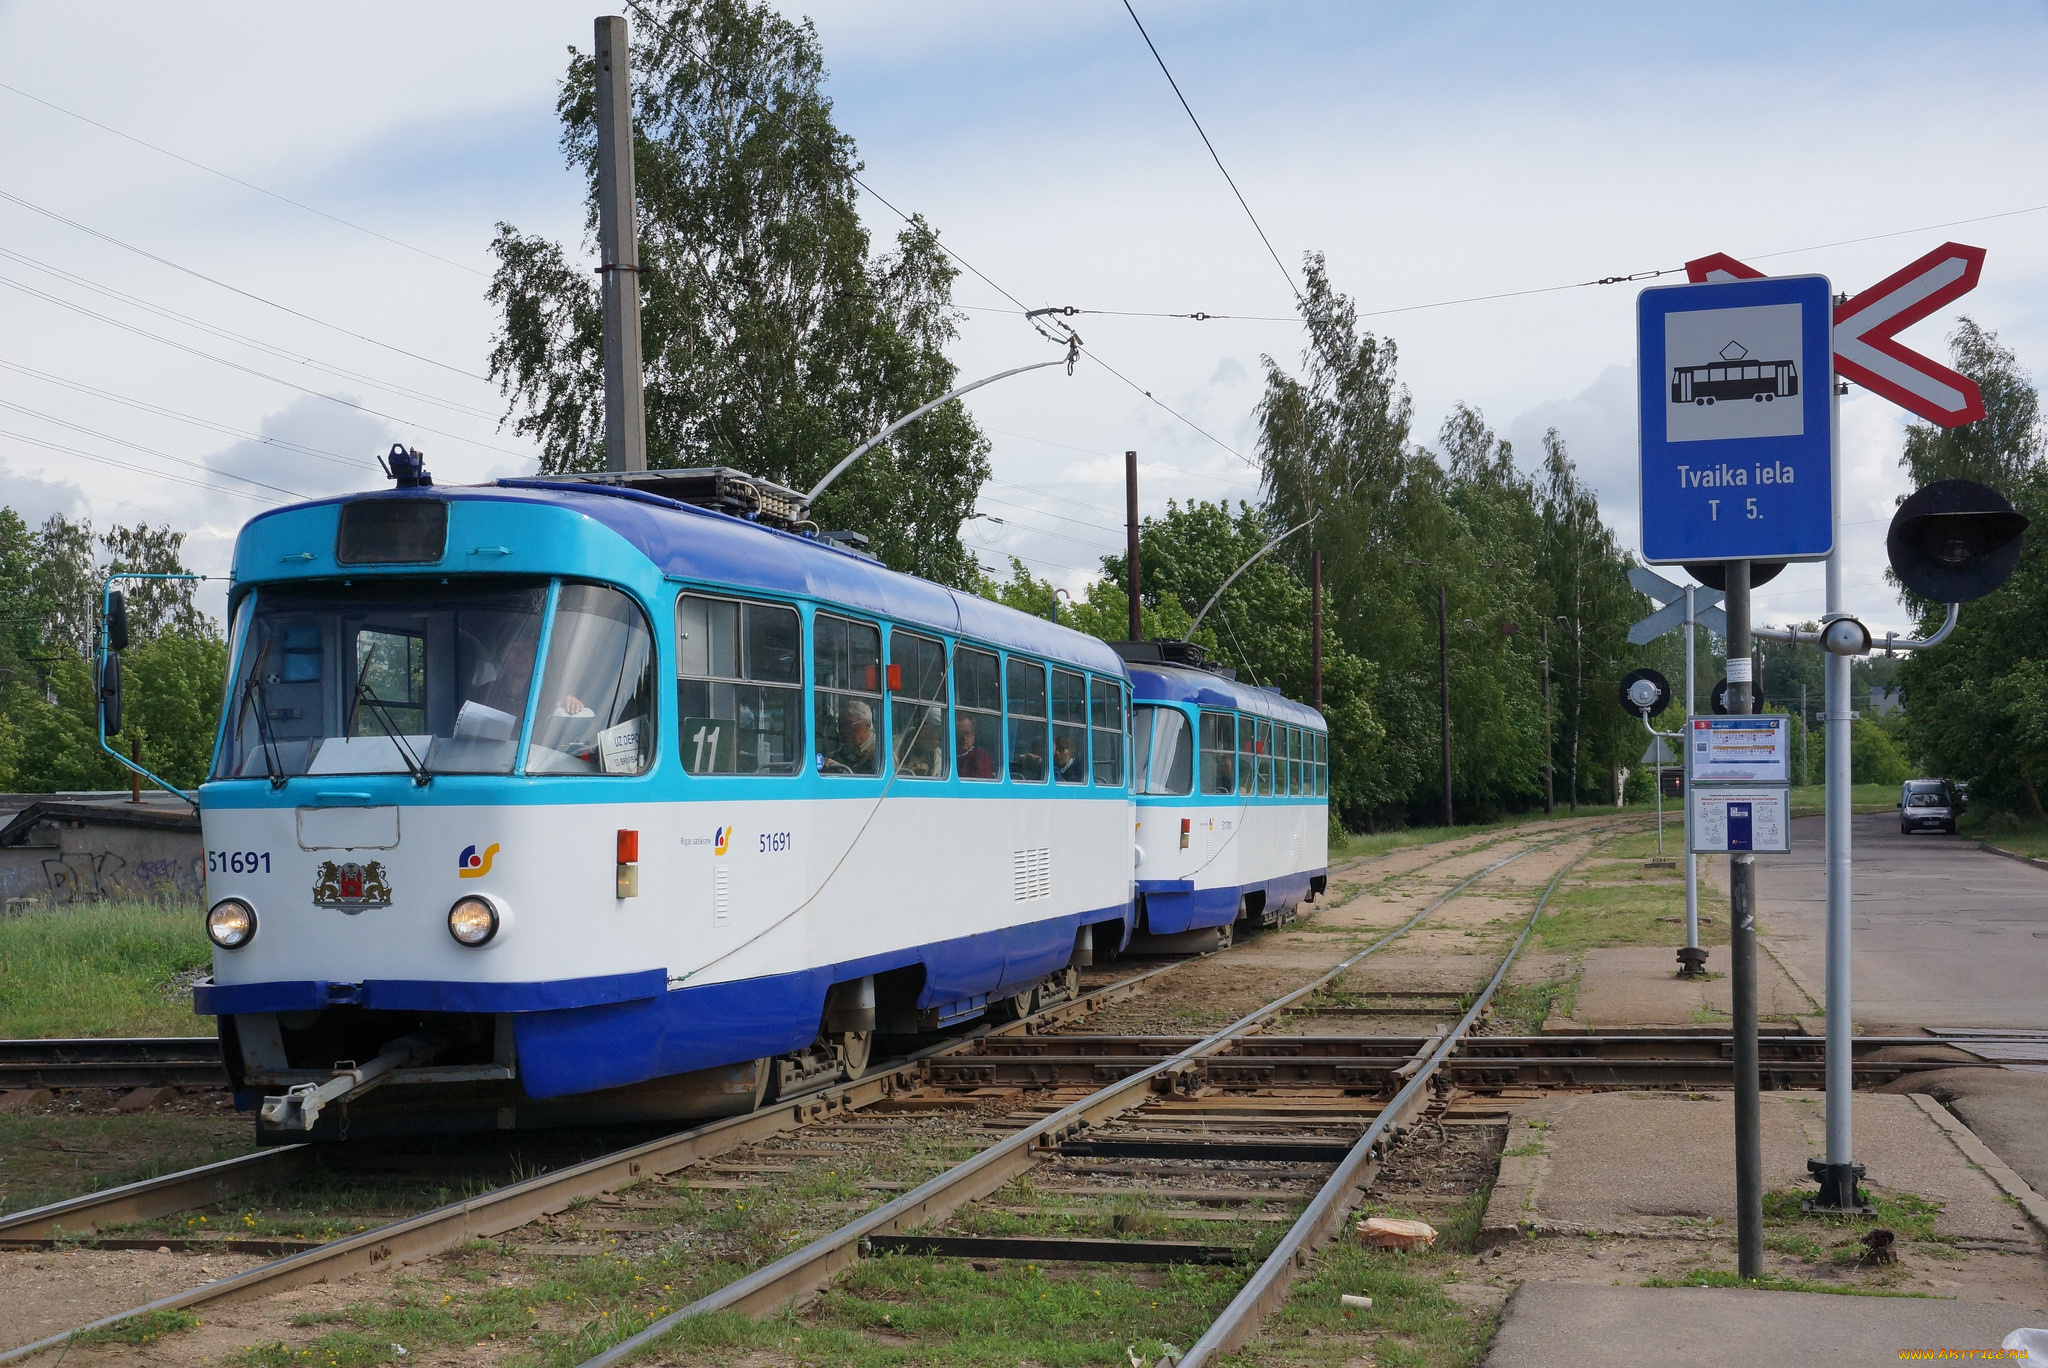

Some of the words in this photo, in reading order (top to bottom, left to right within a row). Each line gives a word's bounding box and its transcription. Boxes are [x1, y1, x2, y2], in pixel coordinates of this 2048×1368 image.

[1677, 463, 1747, 488] Tvaika
[1755, 460, 1794, 485] iela
[1708, 499, 1720, 521] T
[1746, 497, 1764, 520] 5.
[693, 726, 720, 773] 11
[760, 831, 791, 853] 51691
[208, 850, 271, 874] 51691
